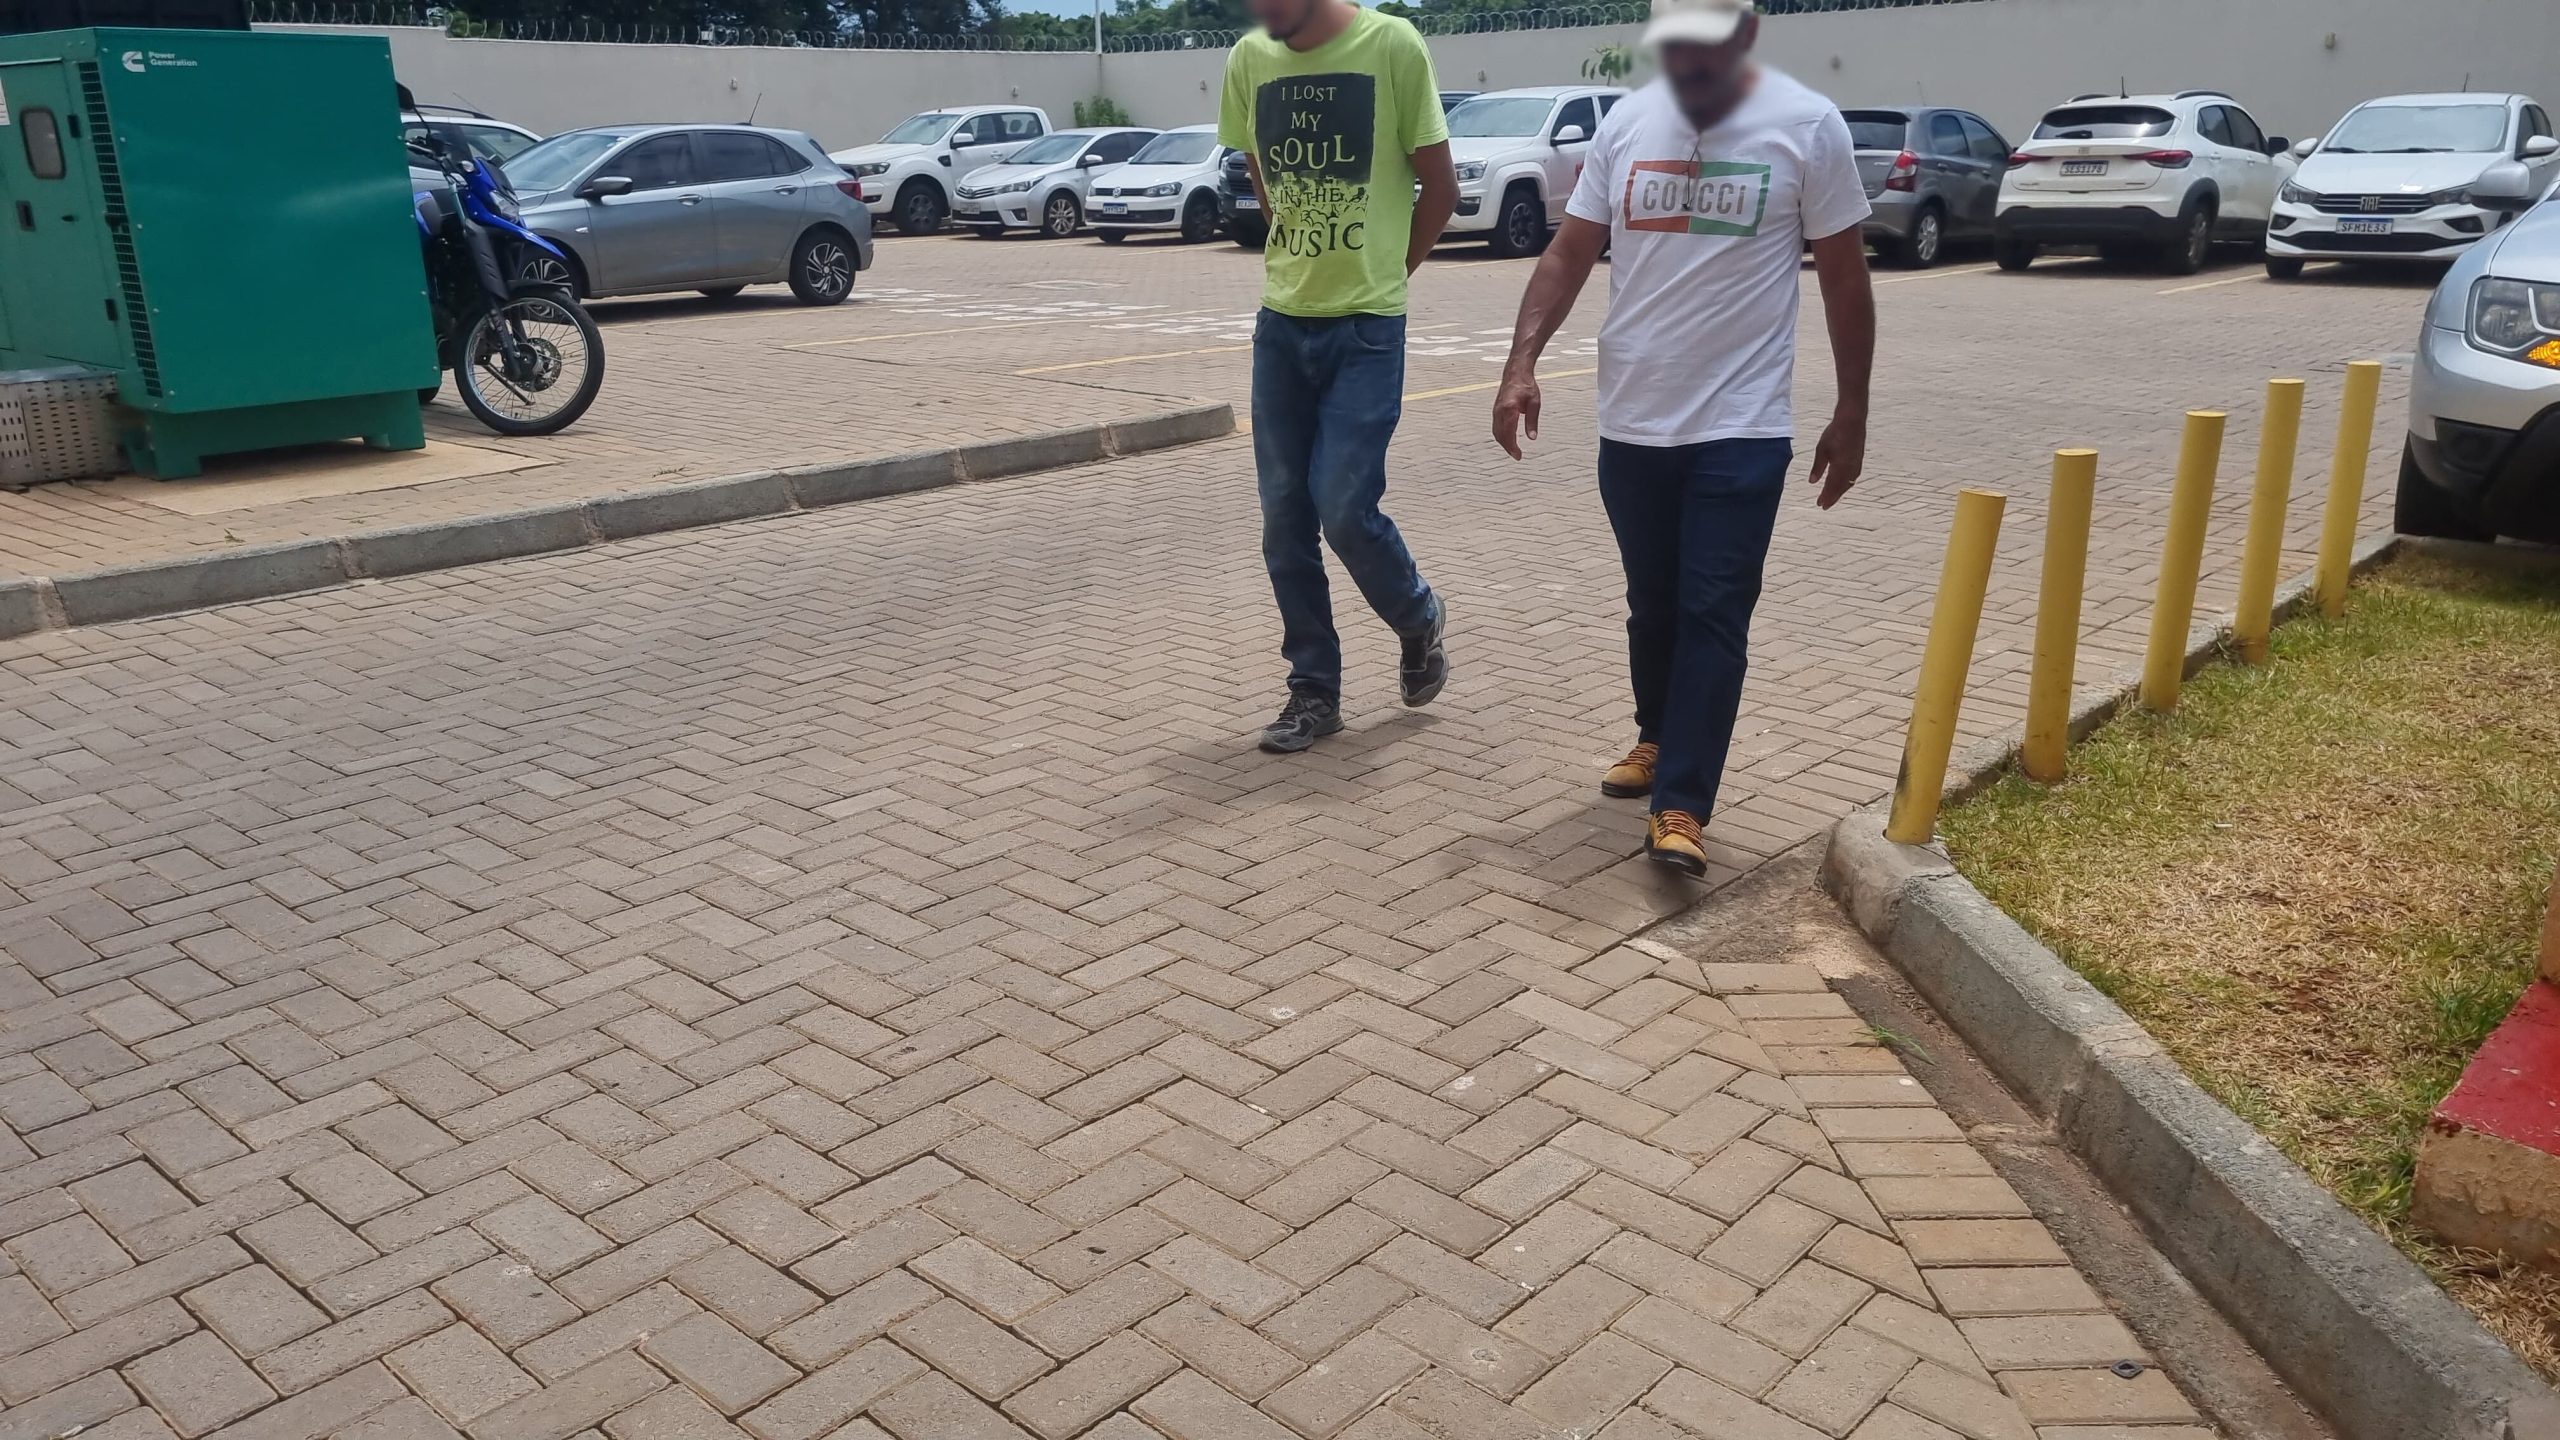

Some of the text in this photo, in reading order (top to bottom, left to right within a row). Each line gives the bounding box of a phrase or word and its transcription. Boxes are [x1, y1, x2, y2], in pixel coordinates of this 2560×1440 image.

[148, 51, 175, 59] Power
[150, 58, 198, 67] Generation
[1281, 85, 1337, 102] I LOST
[1290, 111, 1322, 132] MY
[1269, 134, 1355, 173] SOUL
[1280, 187, 1341, 206] IN THE
[2359, 196, 2381, 211] FIAT
[1268, 222, 1365, 258] MUSIC
